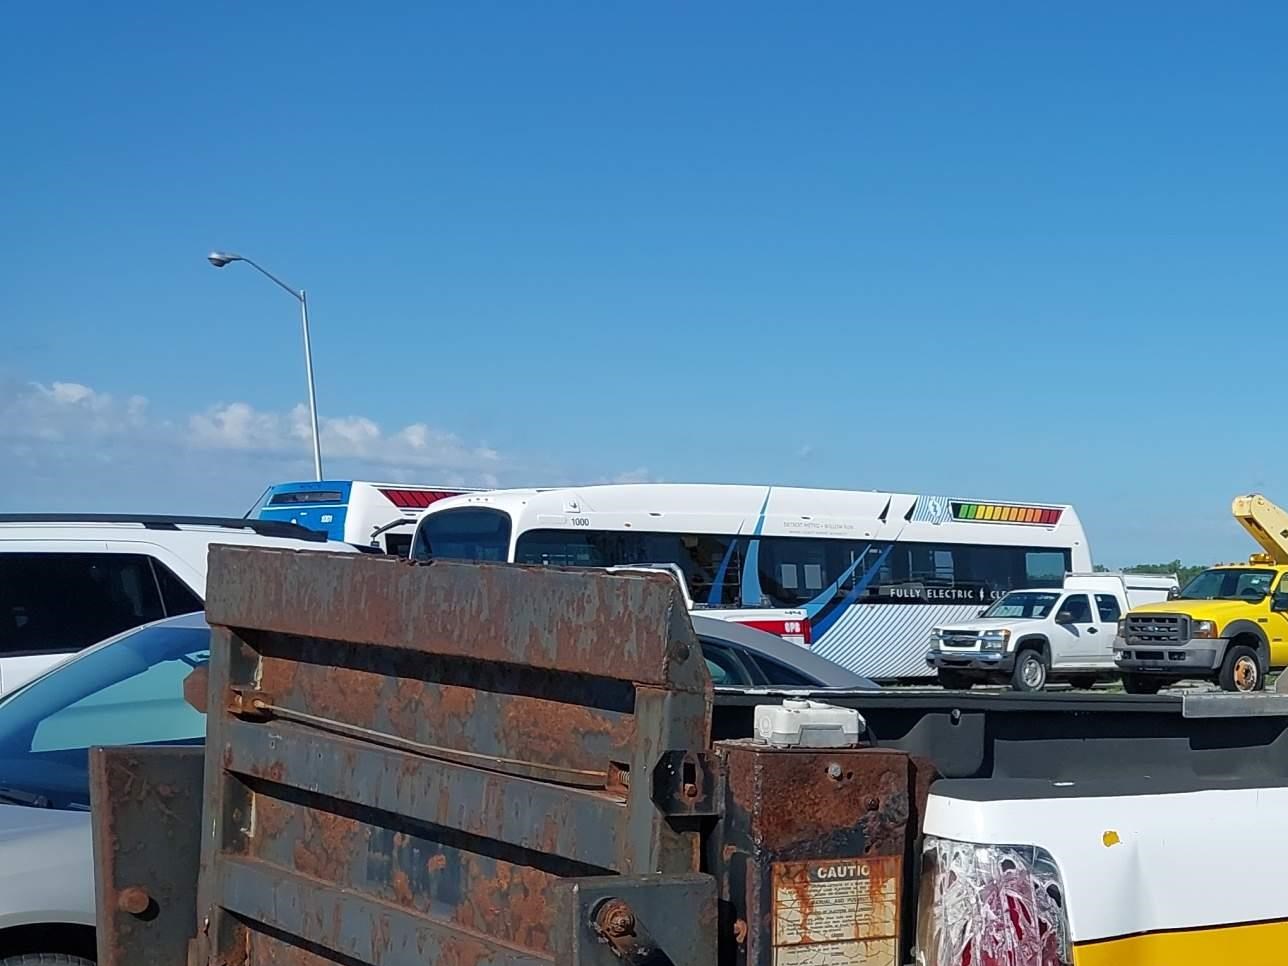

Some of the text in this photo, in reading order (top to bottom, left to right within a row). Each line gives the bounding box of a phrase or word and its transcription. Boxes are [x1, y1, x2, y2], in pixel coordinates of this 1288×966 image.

[571, 518, 589, 526] 1000
[890, 588, 920, 598] FULLY
[927, 589, 974, 599] ELECTRIC
[817, 865, 870, 879] CAUTIO
